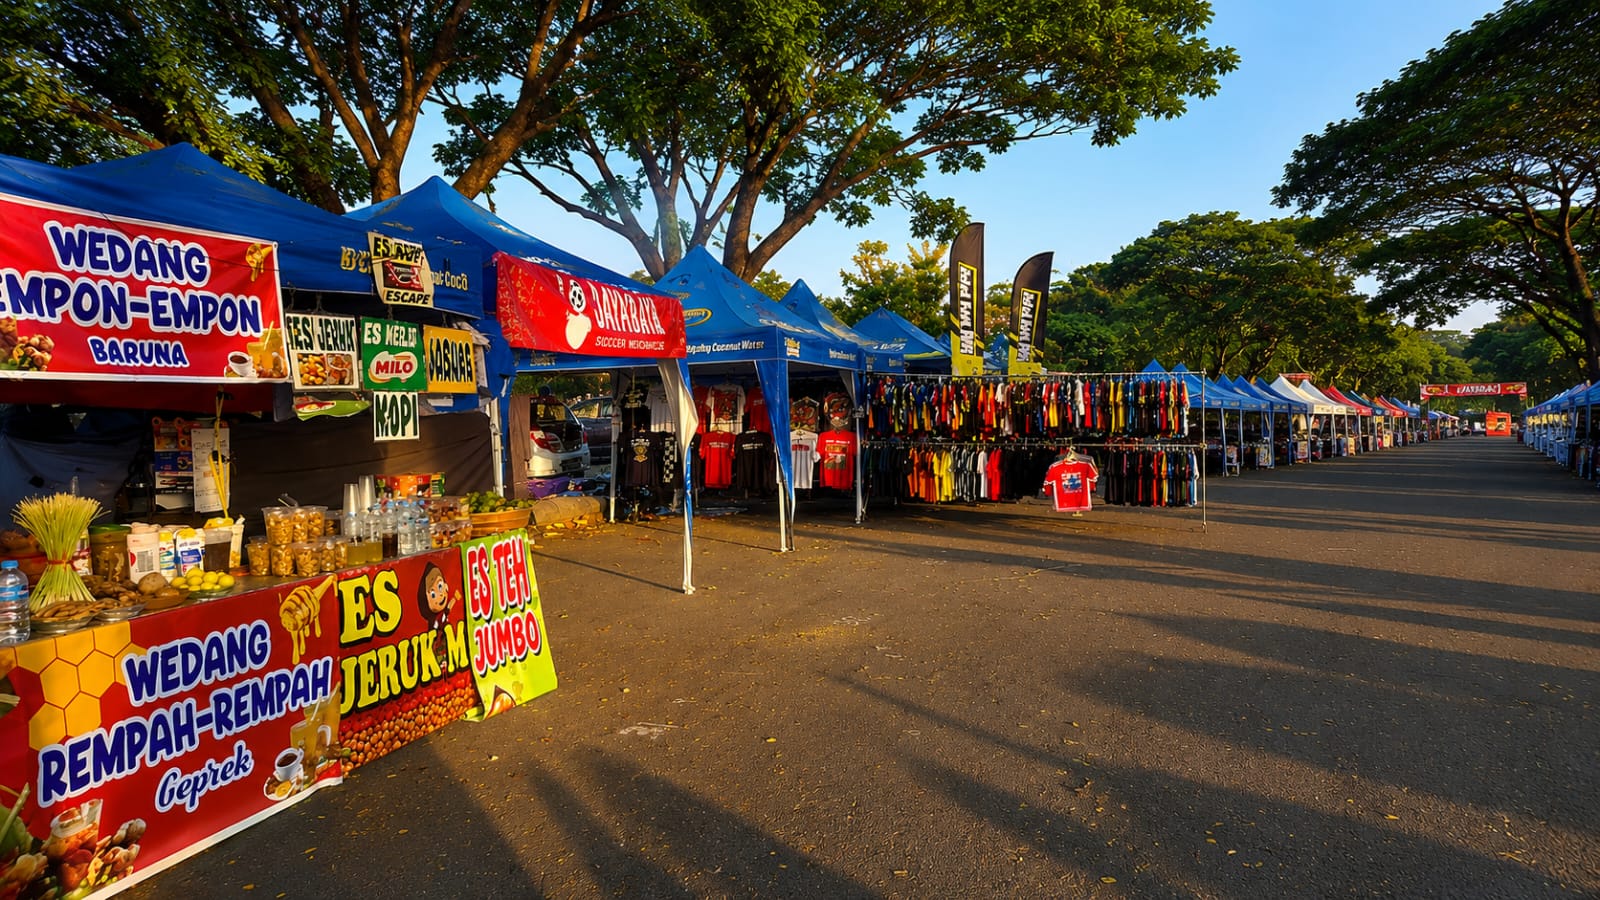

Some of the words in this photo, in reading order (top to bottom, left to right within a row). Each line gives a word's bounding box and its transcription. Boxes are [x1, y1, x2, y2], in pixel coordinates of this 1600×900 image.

[48, 225, 209, 284] WEDANG
[0, 273, 262, 334] MPON-EMPON
[385, 290, 432, 305] ESCAPE
[89, 338, 189, 366] BARUNA
[364, 322, 382, 345] ES
[375, 360, 414, 375] MILO
[338, 569, 403, 645] ES
[467, 545, 493, 619] ES
[492, 537, 531, 608] TEH
[125, 622, 269, 702] WEDANG
[339, 628, 443, 715] JERUK
[473, 611, 540, 673] JUMBO
[41, 659, 331, 803] REMPAH-REMPAH
[157, 744, 252, 809] Geprek
